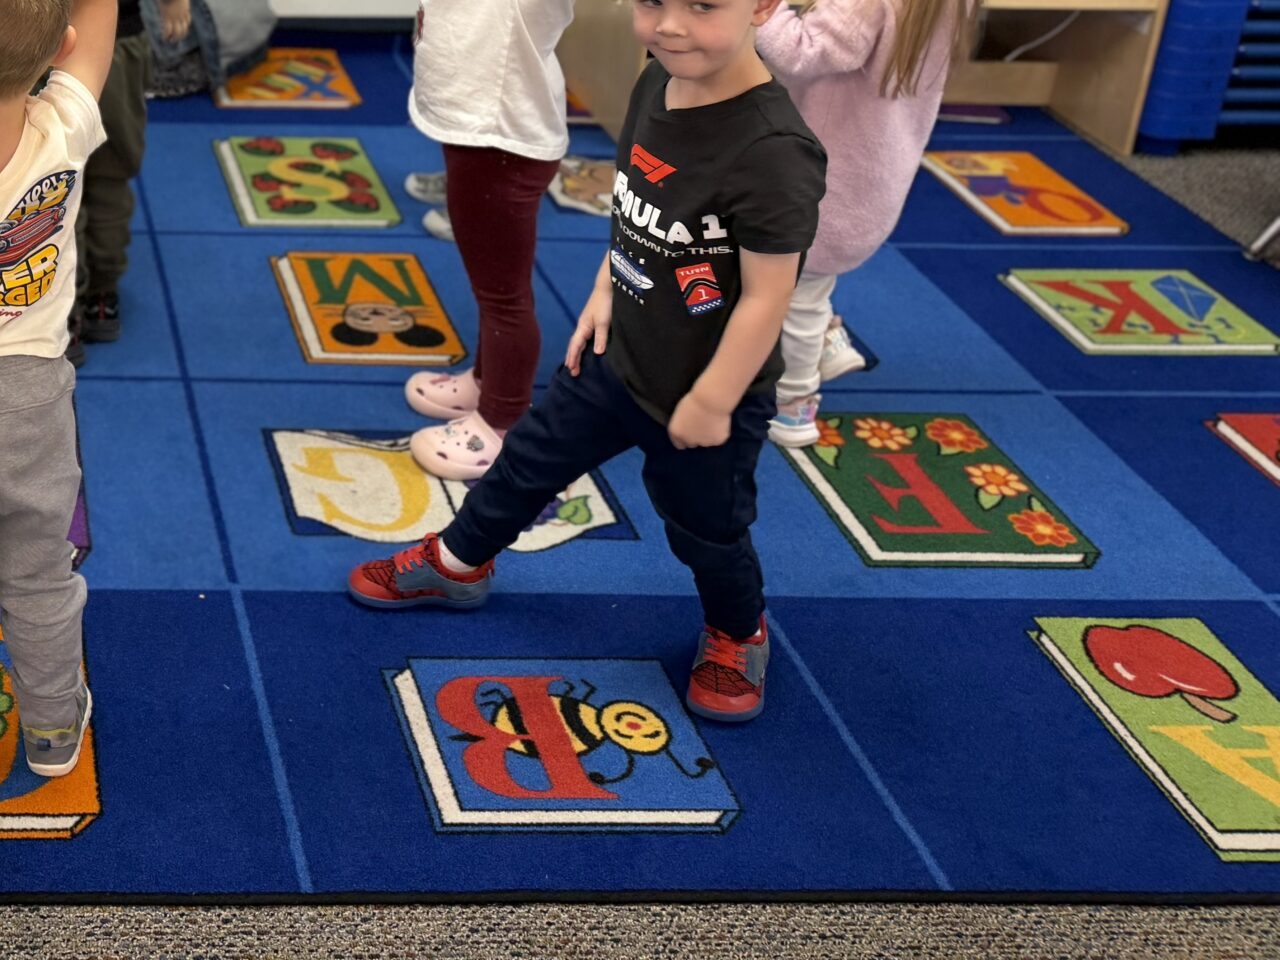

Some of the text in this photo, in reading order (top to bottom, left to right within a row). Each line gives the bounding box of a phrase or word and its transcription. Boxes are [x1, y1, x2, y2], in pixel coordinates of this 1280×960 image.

[266, 156, 351, 201] S
[612, 170, 695, 246] RMULA
[701, 214, 728, 240] 1
[662, 248, 685, 258] TO
[686, 245, 734, 255] THIS.
[679, 266, 710, 277] TURN
[697, 288, 710, 301] 1
[1031, 279, 1200, 336] K
[435, 674, 620, 800] B
